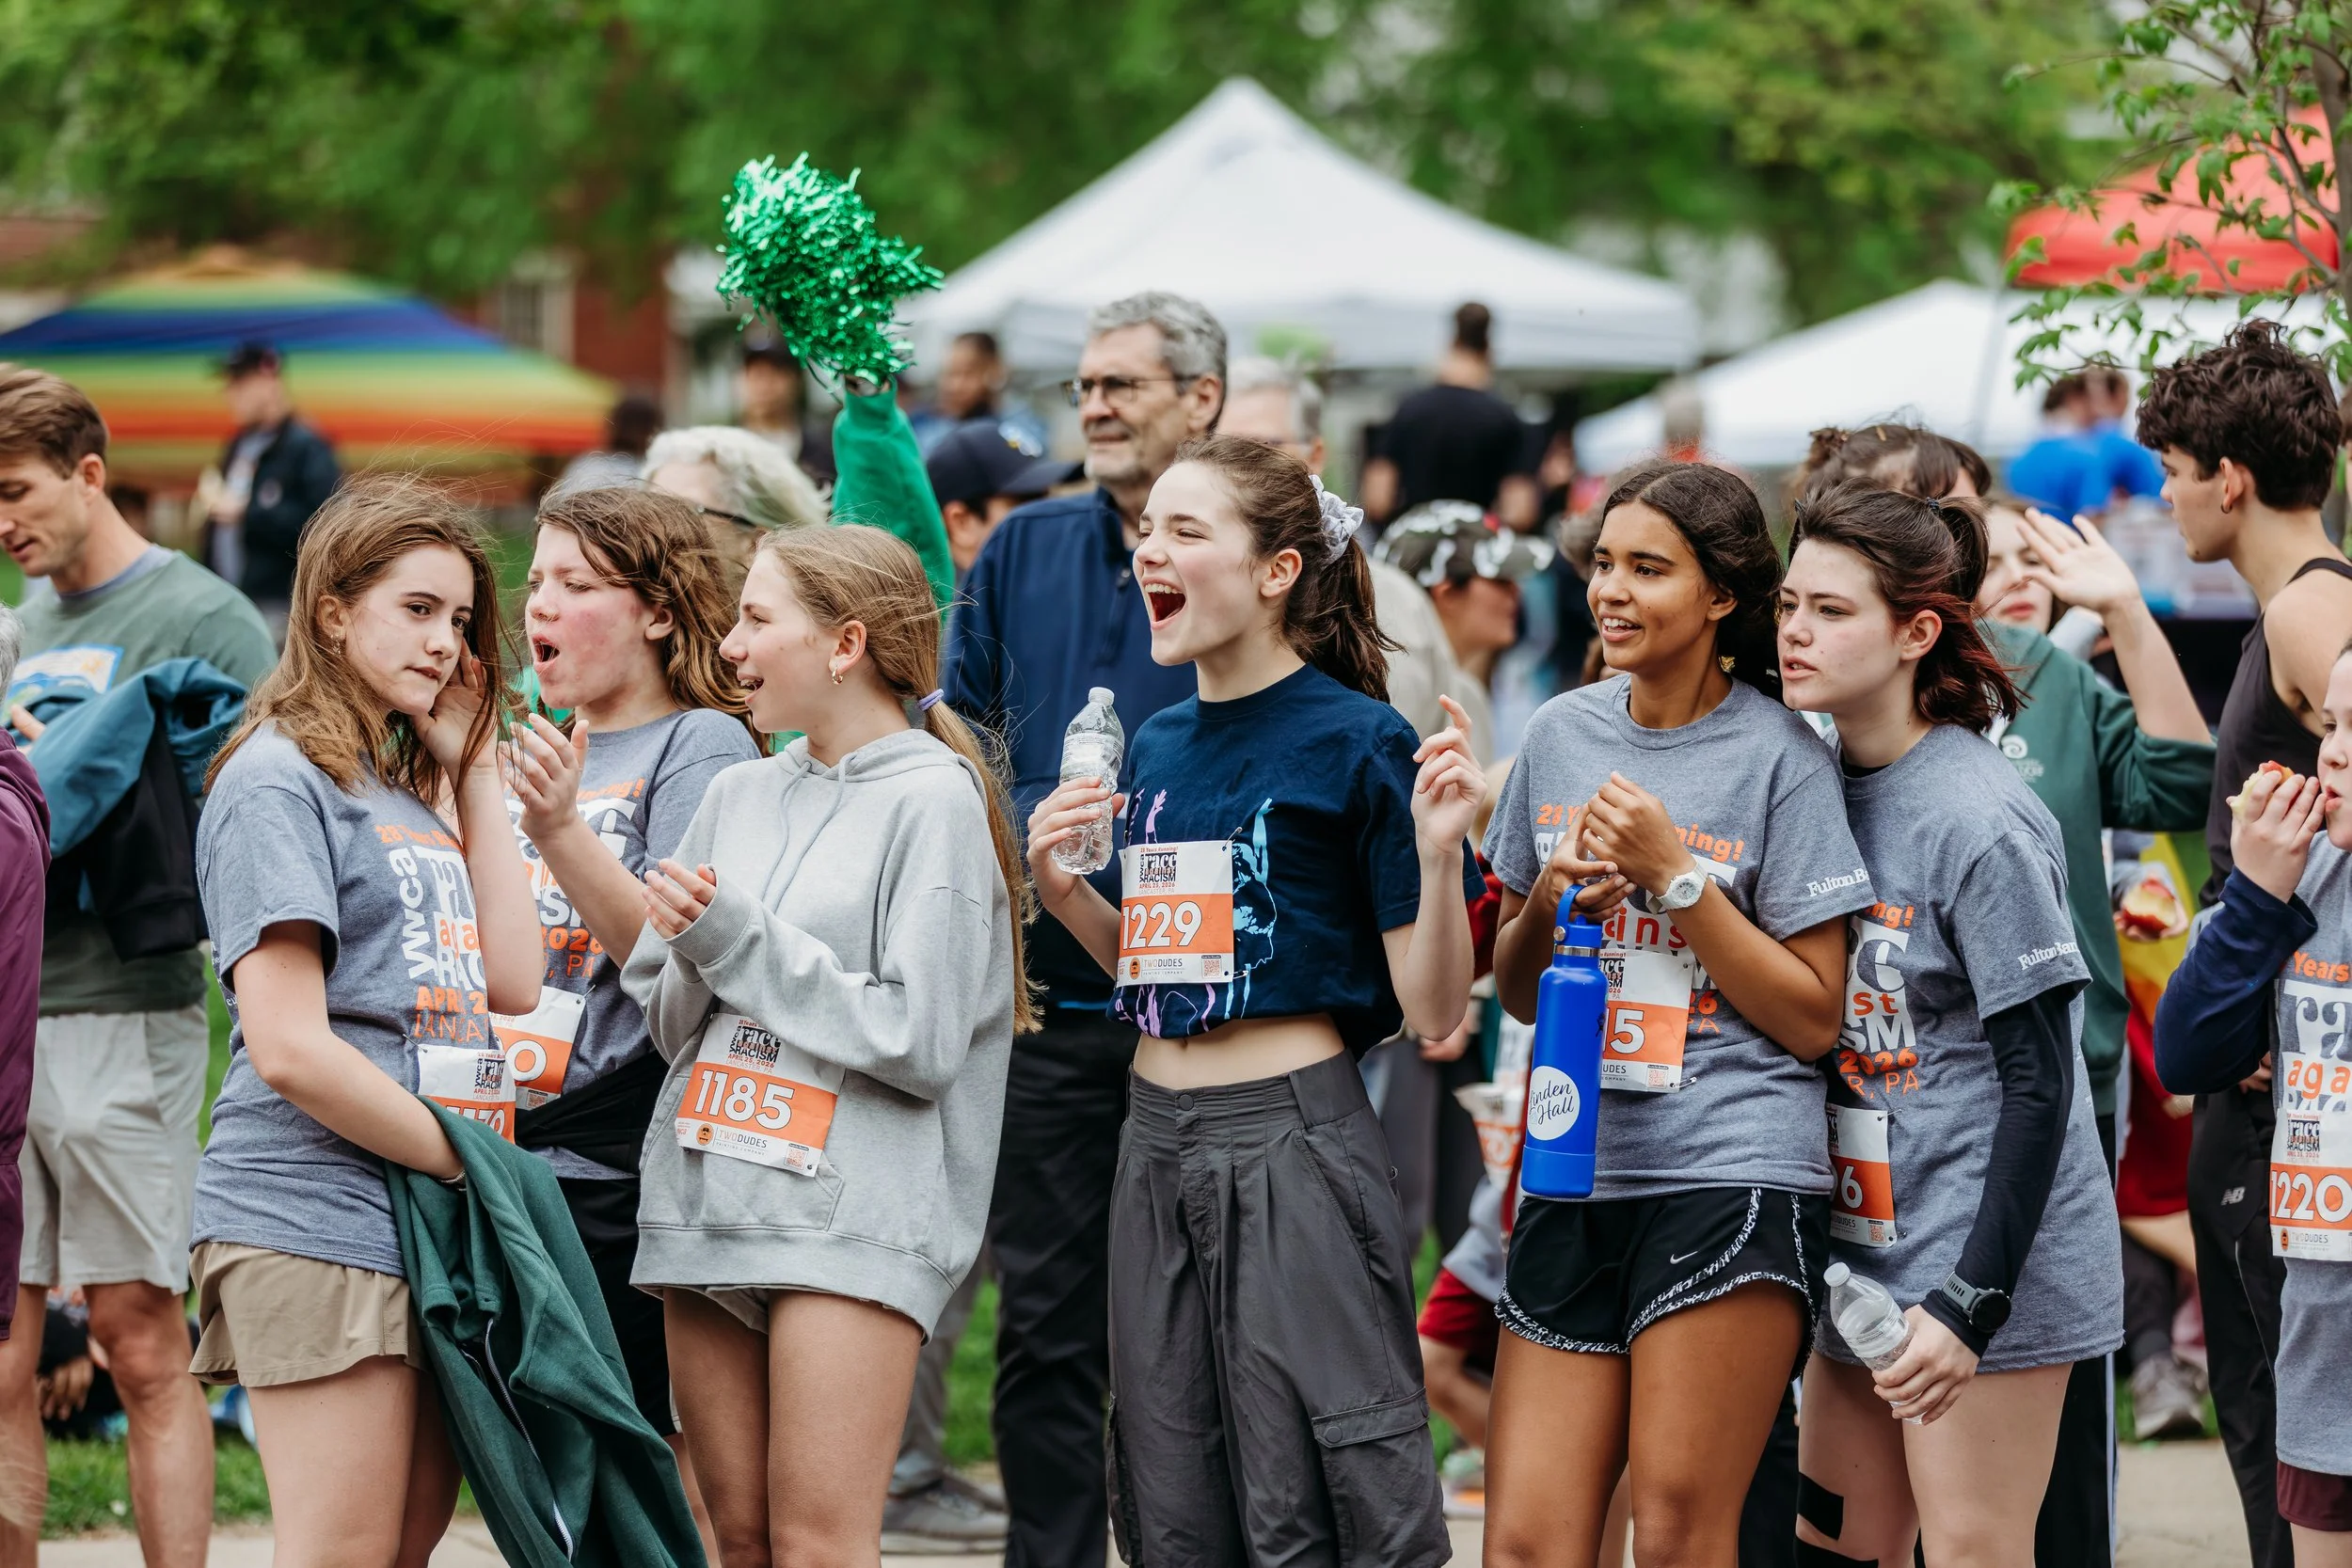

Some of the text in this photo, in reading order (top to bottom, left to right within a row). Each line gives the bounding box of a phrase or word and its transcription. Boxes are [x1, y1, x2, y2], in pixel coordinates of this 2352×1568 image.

[1536, 804, 1564, 826] 28
[1675, 823, 1745, 863] ning!
[1145, 853, 1177, 868] race
[1144, 874, 1176, 882] RACISM
[1122, 901, 1202, 950] 1229
[566, 954, 596, 979] PA
[2293, 950, 2350, 983] Years
[739, 1026, 782, 1048] race
[727, 1053, 743, 1062] APRIL
[756, 1059, 775, 1069] 2026
[735, 1046, 780, 1063] RACISM
[1838, 1046, 1919, 1076] 2026
[1884, 1069, 1919, 1096] PA
[693, 1069, 795, 1131] 1185
[1537, 1096, 1575, 1125] Hall
[2271, 1170, 2352, 1224] 1220
